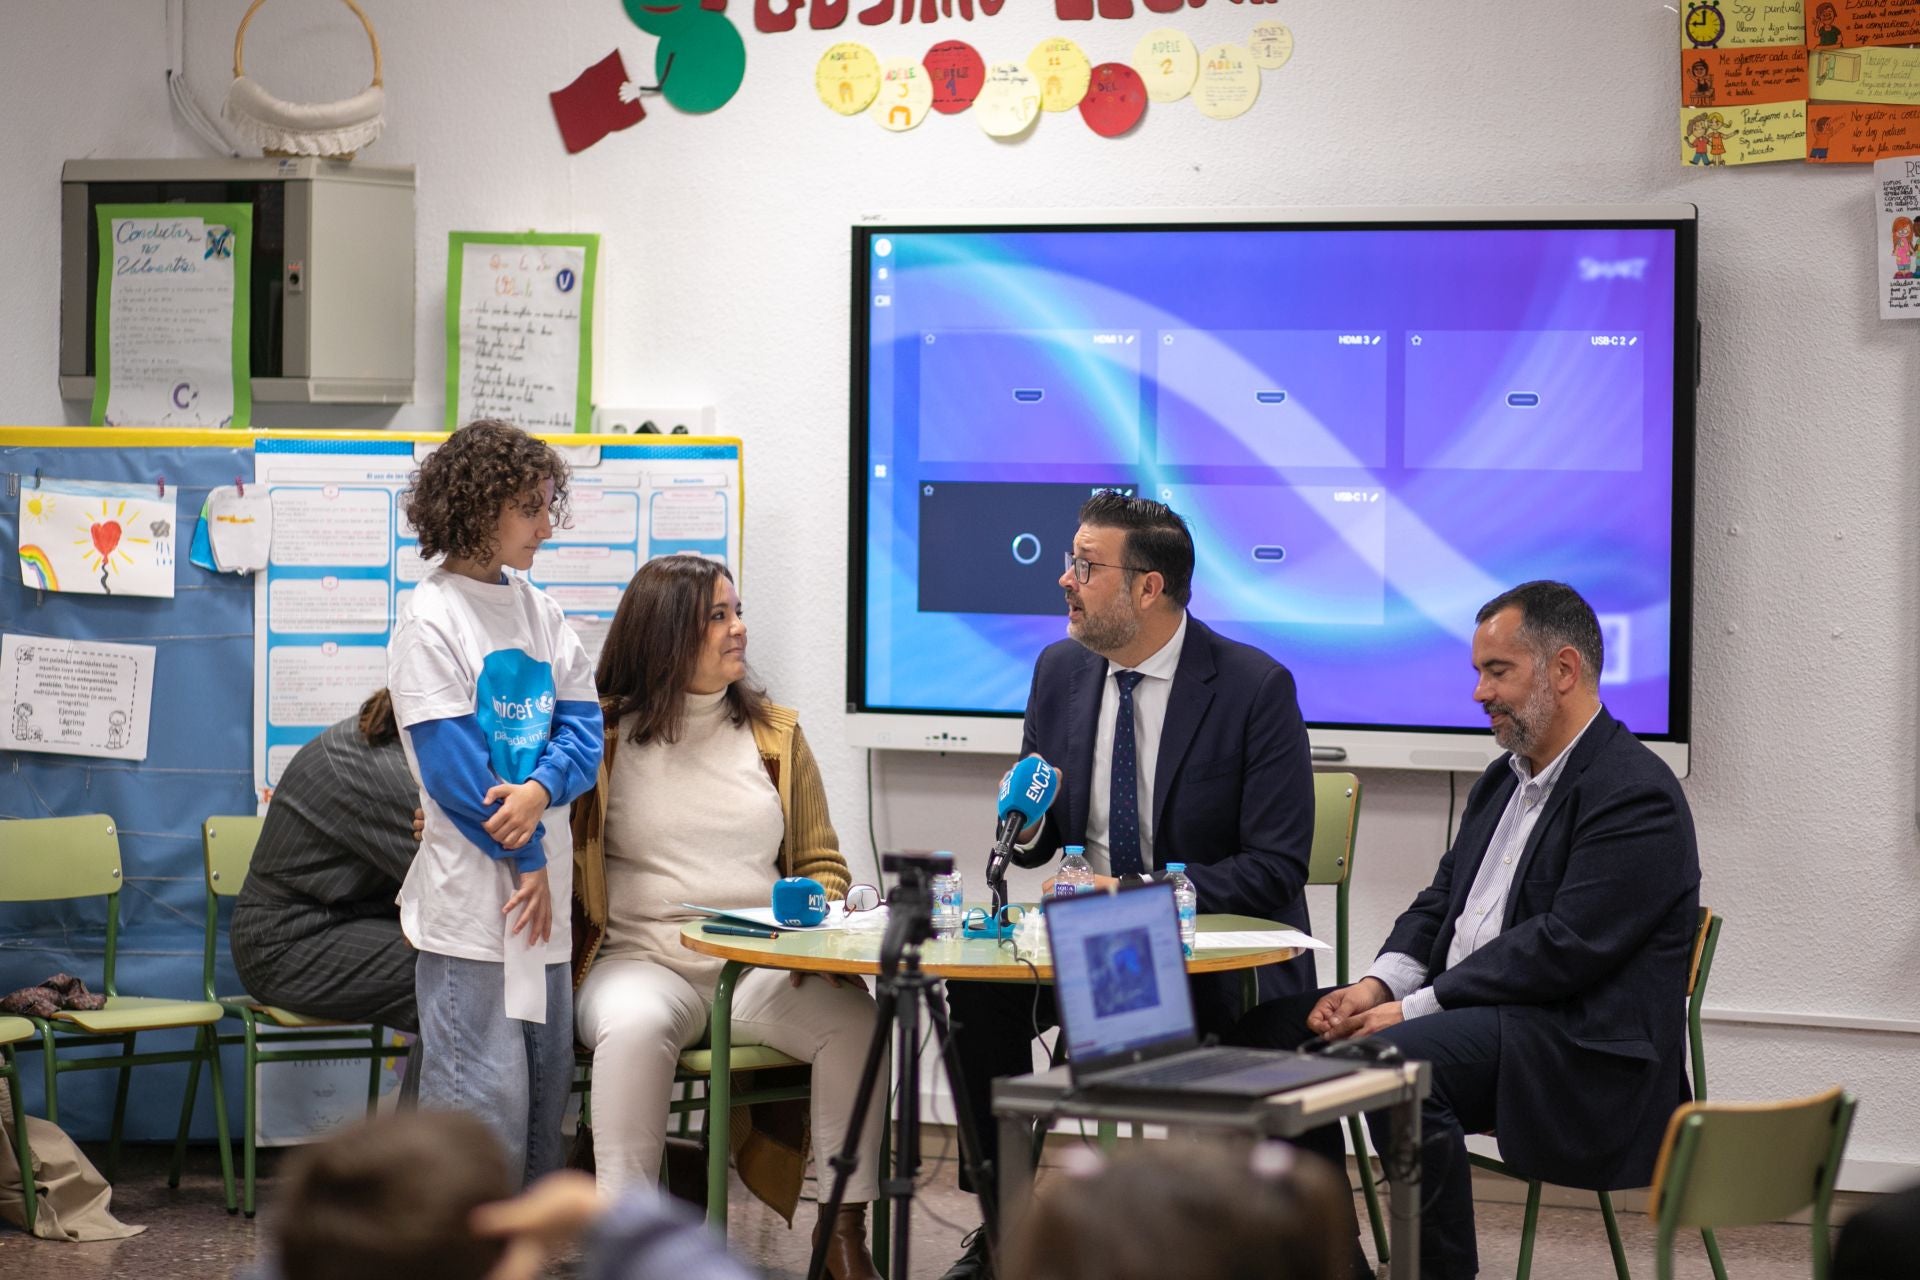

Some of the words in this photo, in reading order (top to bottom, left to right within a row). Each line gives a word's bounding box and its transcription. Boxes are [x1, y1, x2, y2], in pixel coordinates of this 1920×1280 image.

[1732, 0, 1755, 21] Soy
[1769, 52, 1789, 61] cada
[1338, 335, 1362, 345] HDMI
[1363, 335, 1370, 345] 3
[1591, 336, 1618, 346] USB-C
[1619, 336, 1626, 346] 2
